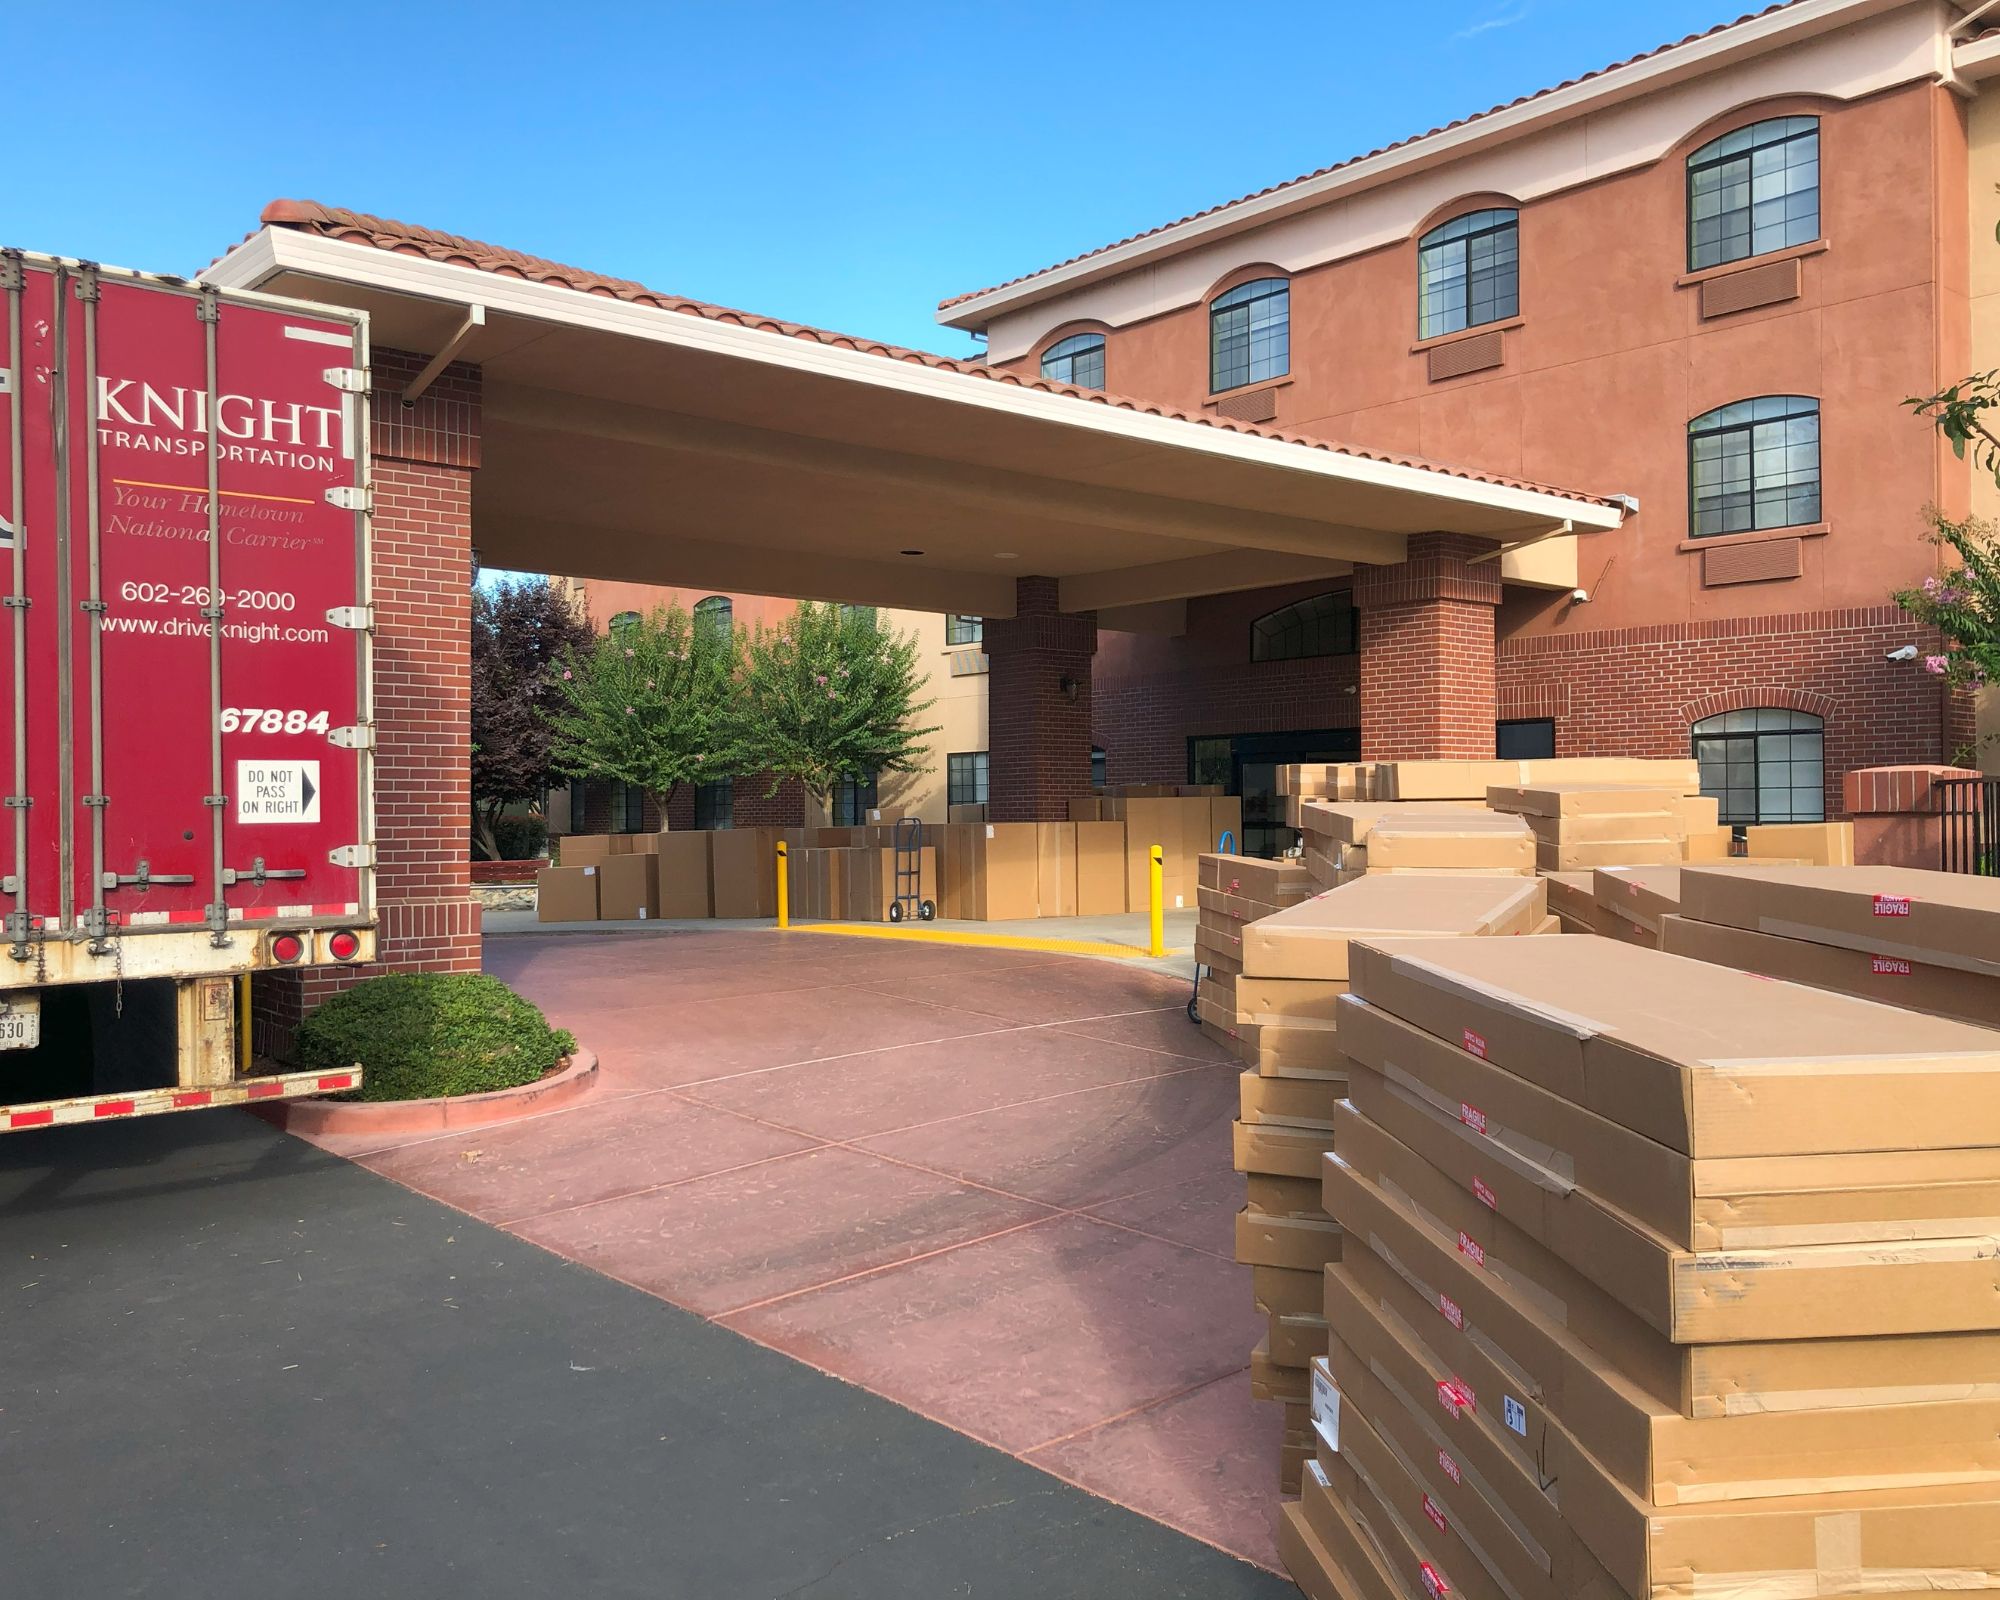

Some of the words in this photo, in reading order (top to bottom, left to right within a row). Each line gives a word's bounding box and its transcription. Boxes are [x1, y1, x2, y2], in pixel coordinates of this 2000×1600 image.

[96, 376, 342, 449] KNIGHT
[97, 429, 334, 473] TRANSPORTATION
[114, 486, 172, 510] Your
[106, 514, 219, 542] Nationa
[226, 526, 311, 550] Carrier
[100, 616, 328, 643] www.driveknight.com
[220, 708, 329, 735] 67884
[248, 770, 264, 783] DO
[270, 770, 293, 783] NOT
[256, 785, 285, 798] PASS
[242, 801, 259, 814] ON
[265, 801, 298, 814] RIGHT
[1874, 902, 1909, 915] FRAGILE
[1873, 960, 1910, 974] FRAGILE
[0, 1022, 23, 1038] 630
[1462, 1103, 1486, 1129] FRAGILE
[1460, 1231, 1484, 1265] FRAGILE
